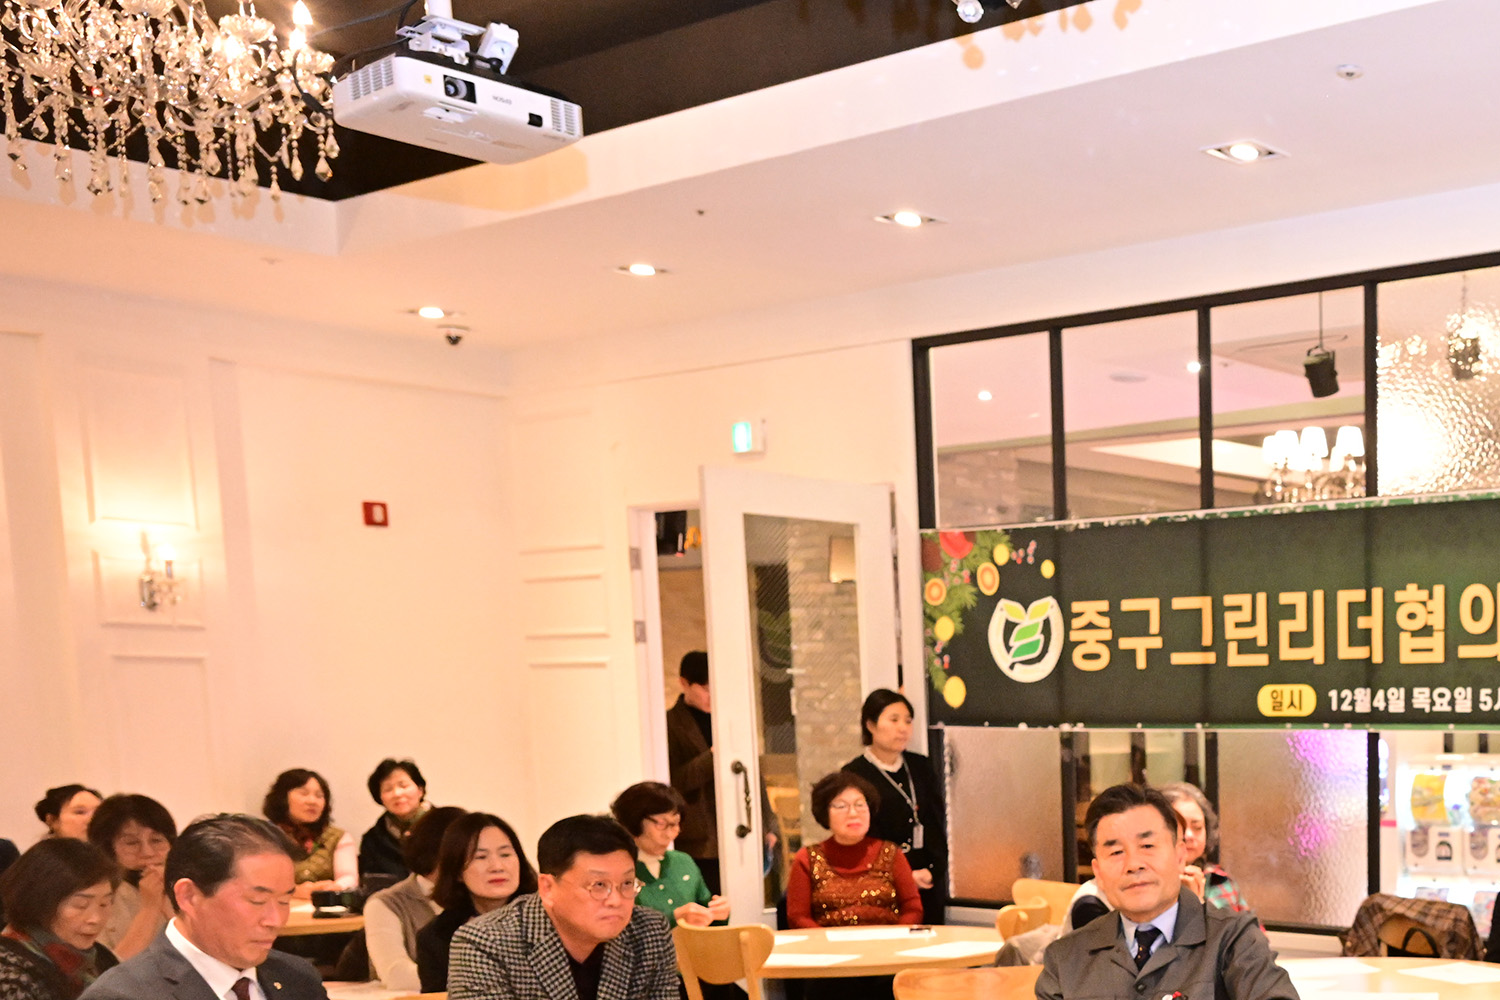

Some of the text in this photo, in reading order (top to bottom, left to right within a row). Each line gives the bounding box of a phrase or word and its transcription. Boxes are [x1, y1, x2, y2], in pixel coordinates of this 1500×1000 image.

[1270, 689, 1304, 711] 일시
[1328, 687, 1406, 712] 12월4일
[1411, 687, 1473, 712] 목요일
